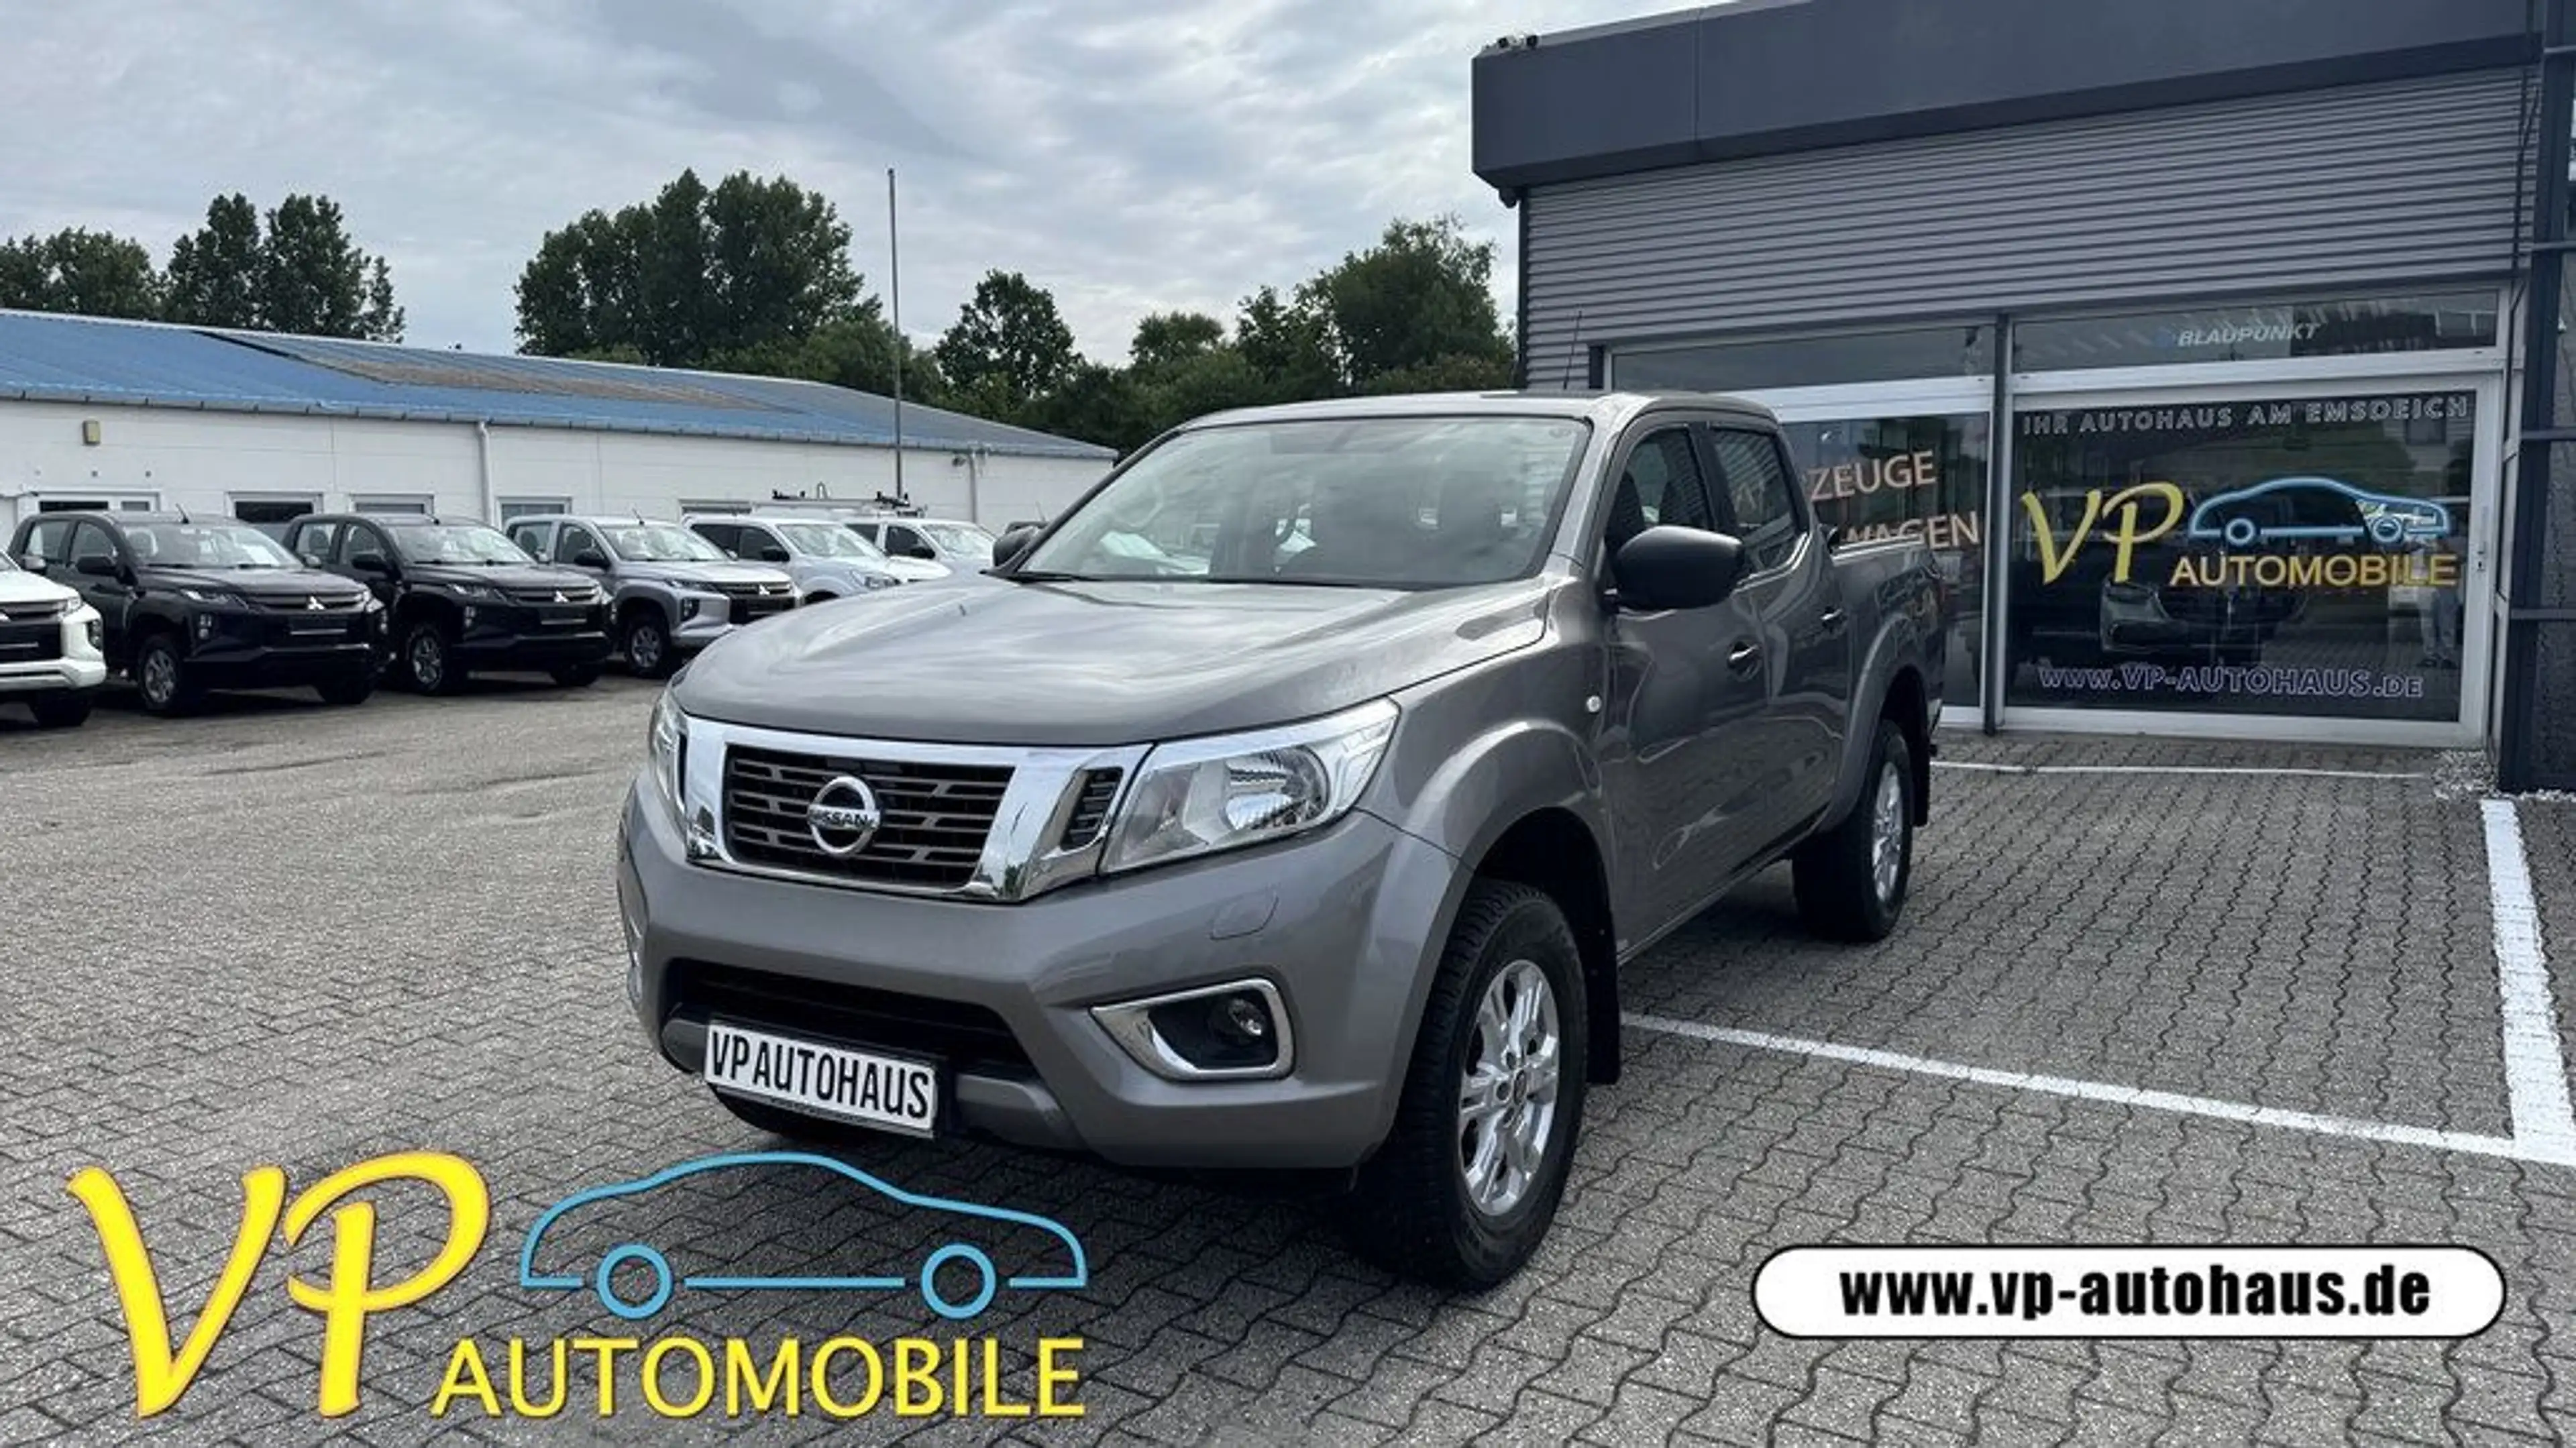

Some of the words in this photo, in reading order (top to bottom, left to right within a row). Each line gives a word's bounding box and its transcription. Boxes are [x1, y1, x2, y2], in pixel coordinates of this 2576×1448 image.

[2178, 323, 2321, 347] BLAUPUNKT
[2023, 413, 2069, 435] IHR
[2079, 407, 2233, 433] AUTOHAUS
[2247, 402, 2292, 425] AM
[2305, 396, 2468, 423] EMSDEICH
[1803, 449, 1937, 502] ZEUGE
[2019, 481, 2184, 586] VP
[2169, 554, 2457, 588] AUTOMOBILE
